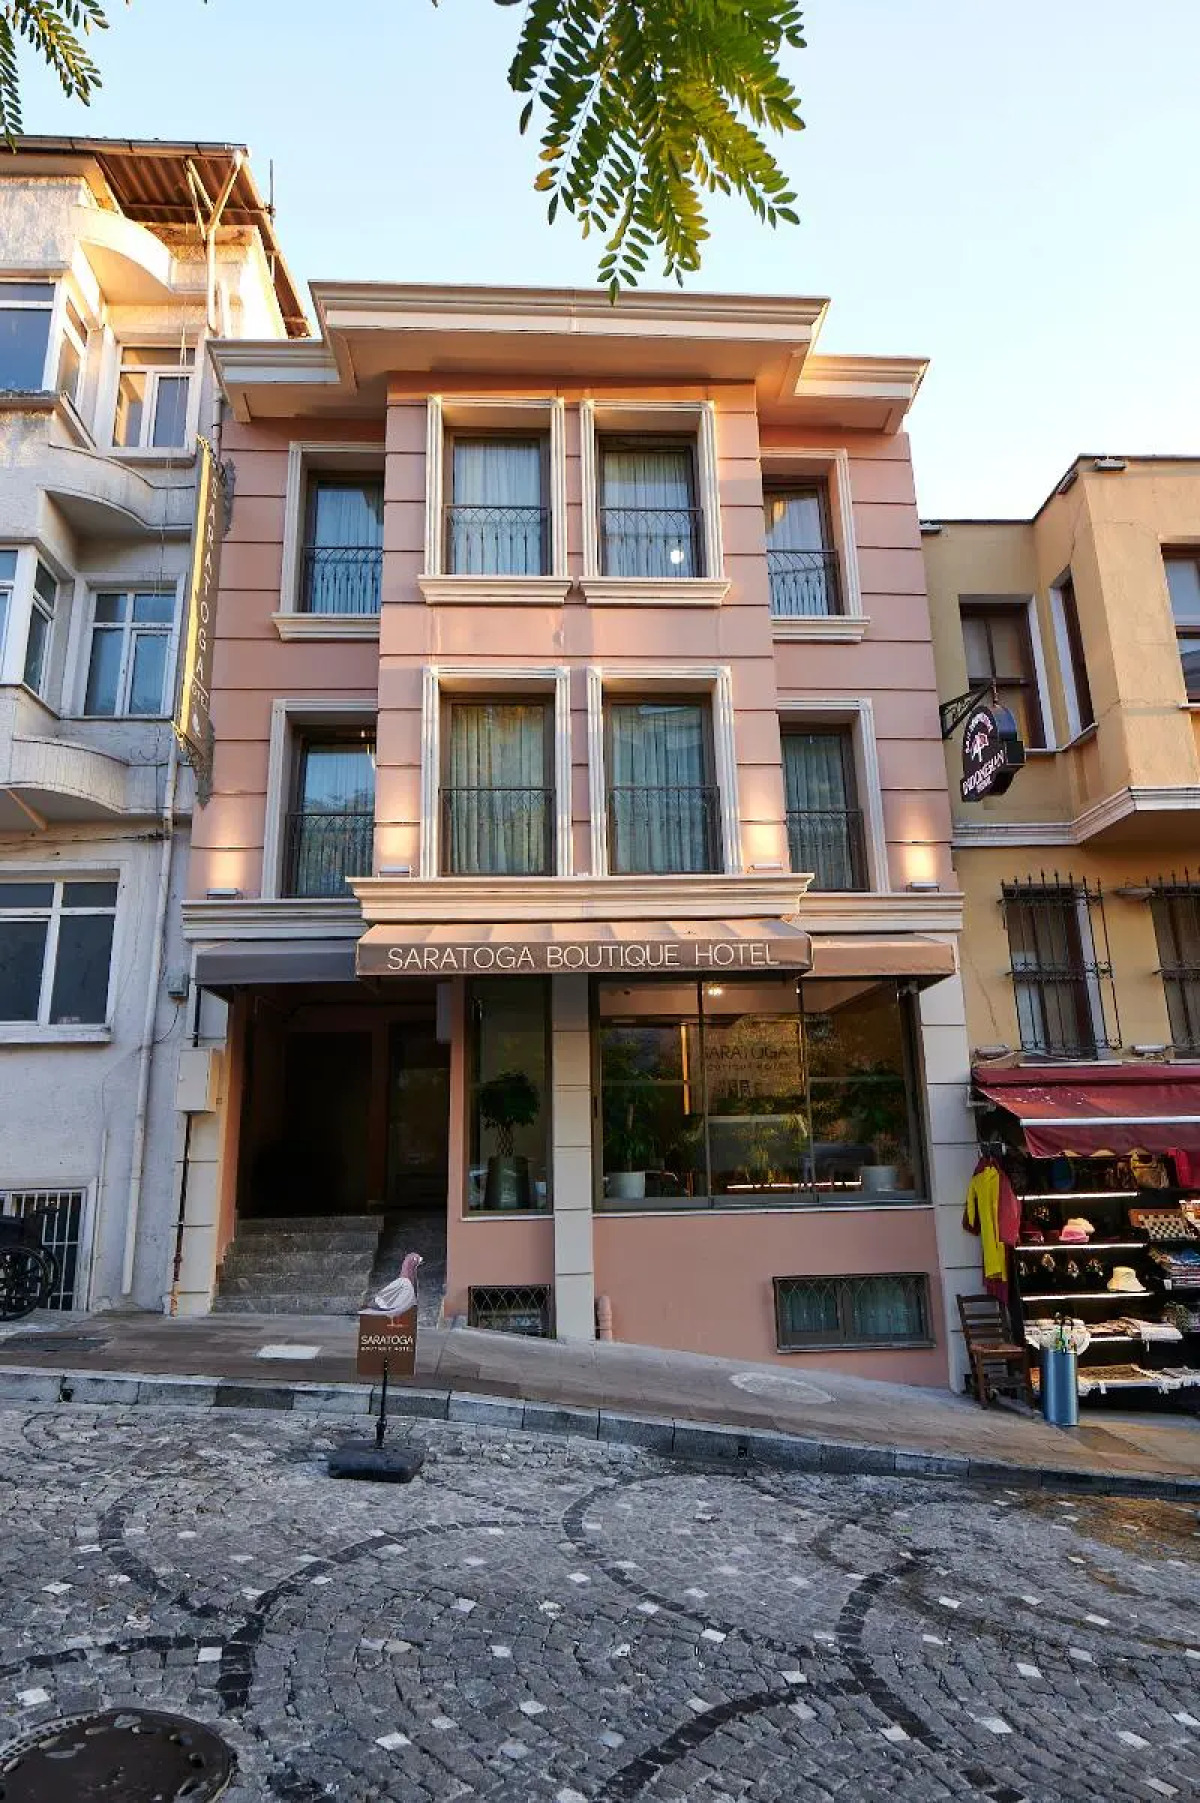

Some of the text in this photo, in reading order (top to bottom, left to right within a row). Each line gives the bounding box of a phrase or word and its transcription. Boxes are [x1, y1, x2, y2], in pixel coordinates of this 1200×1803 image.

[196, 477, 218, 681] SARATOGA
[387, 943, 780, 970] SARATOGA BOUTIQUE HOTEL
[360, 1334, 414, 1345] SARATOGA
